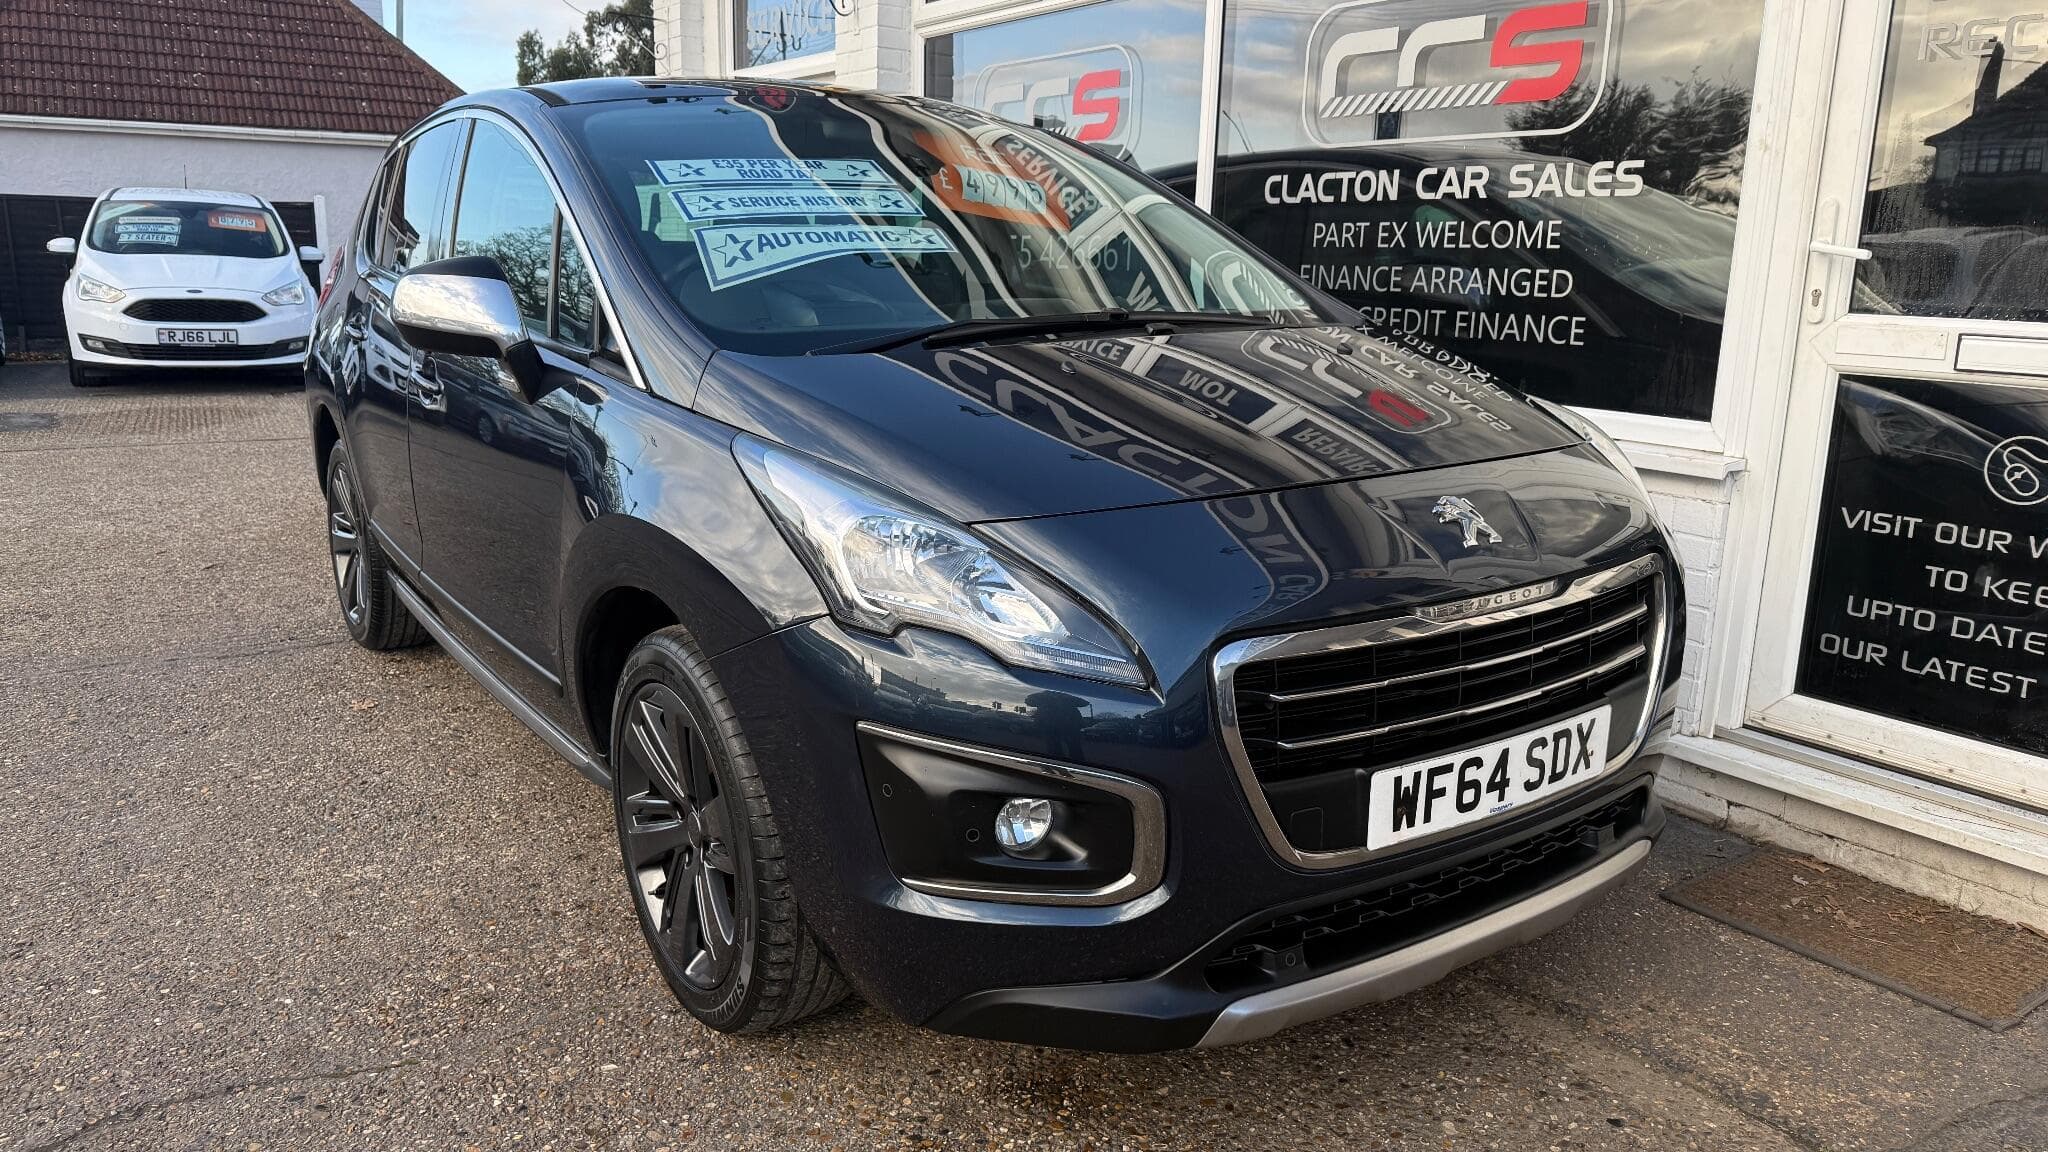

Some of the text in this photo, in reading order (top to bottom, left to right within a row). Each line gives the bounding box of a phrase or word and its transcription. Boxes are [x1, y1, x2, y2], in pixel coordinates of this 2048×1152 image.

[711, 159, 744, 169] £35
[749, 160, 783, 169] PER
[737, 169, 783, 179] ROAD
[966, 169, 1044, 203] 4995
[1264, 159, 1646, 205] CLACTON CAR SALES
[728, 196, 869, 208] SERVICE HISTORY
[757, 228, 901, 253] AUTOMATIC
[1313, 219, 1562, 249] PART EX WELCOME
[1300, 264, 1574, 299] FINANCE ARRANGED
[167, 331, 236, 343] RJ66 LJL
[1454, 311, 1587, 346] FINANCE
[1840, 506, 1923, 539] VISIT
[1934, 522, 2013, 554] OUR
[1924, 565, 1969, 593] TO
[1846, 595, 2048, 656] UPTO DATE
[1818, 632, 2038, 699] OUR LATEST
[1392, 717, 1597, 833] WF64 SDX
